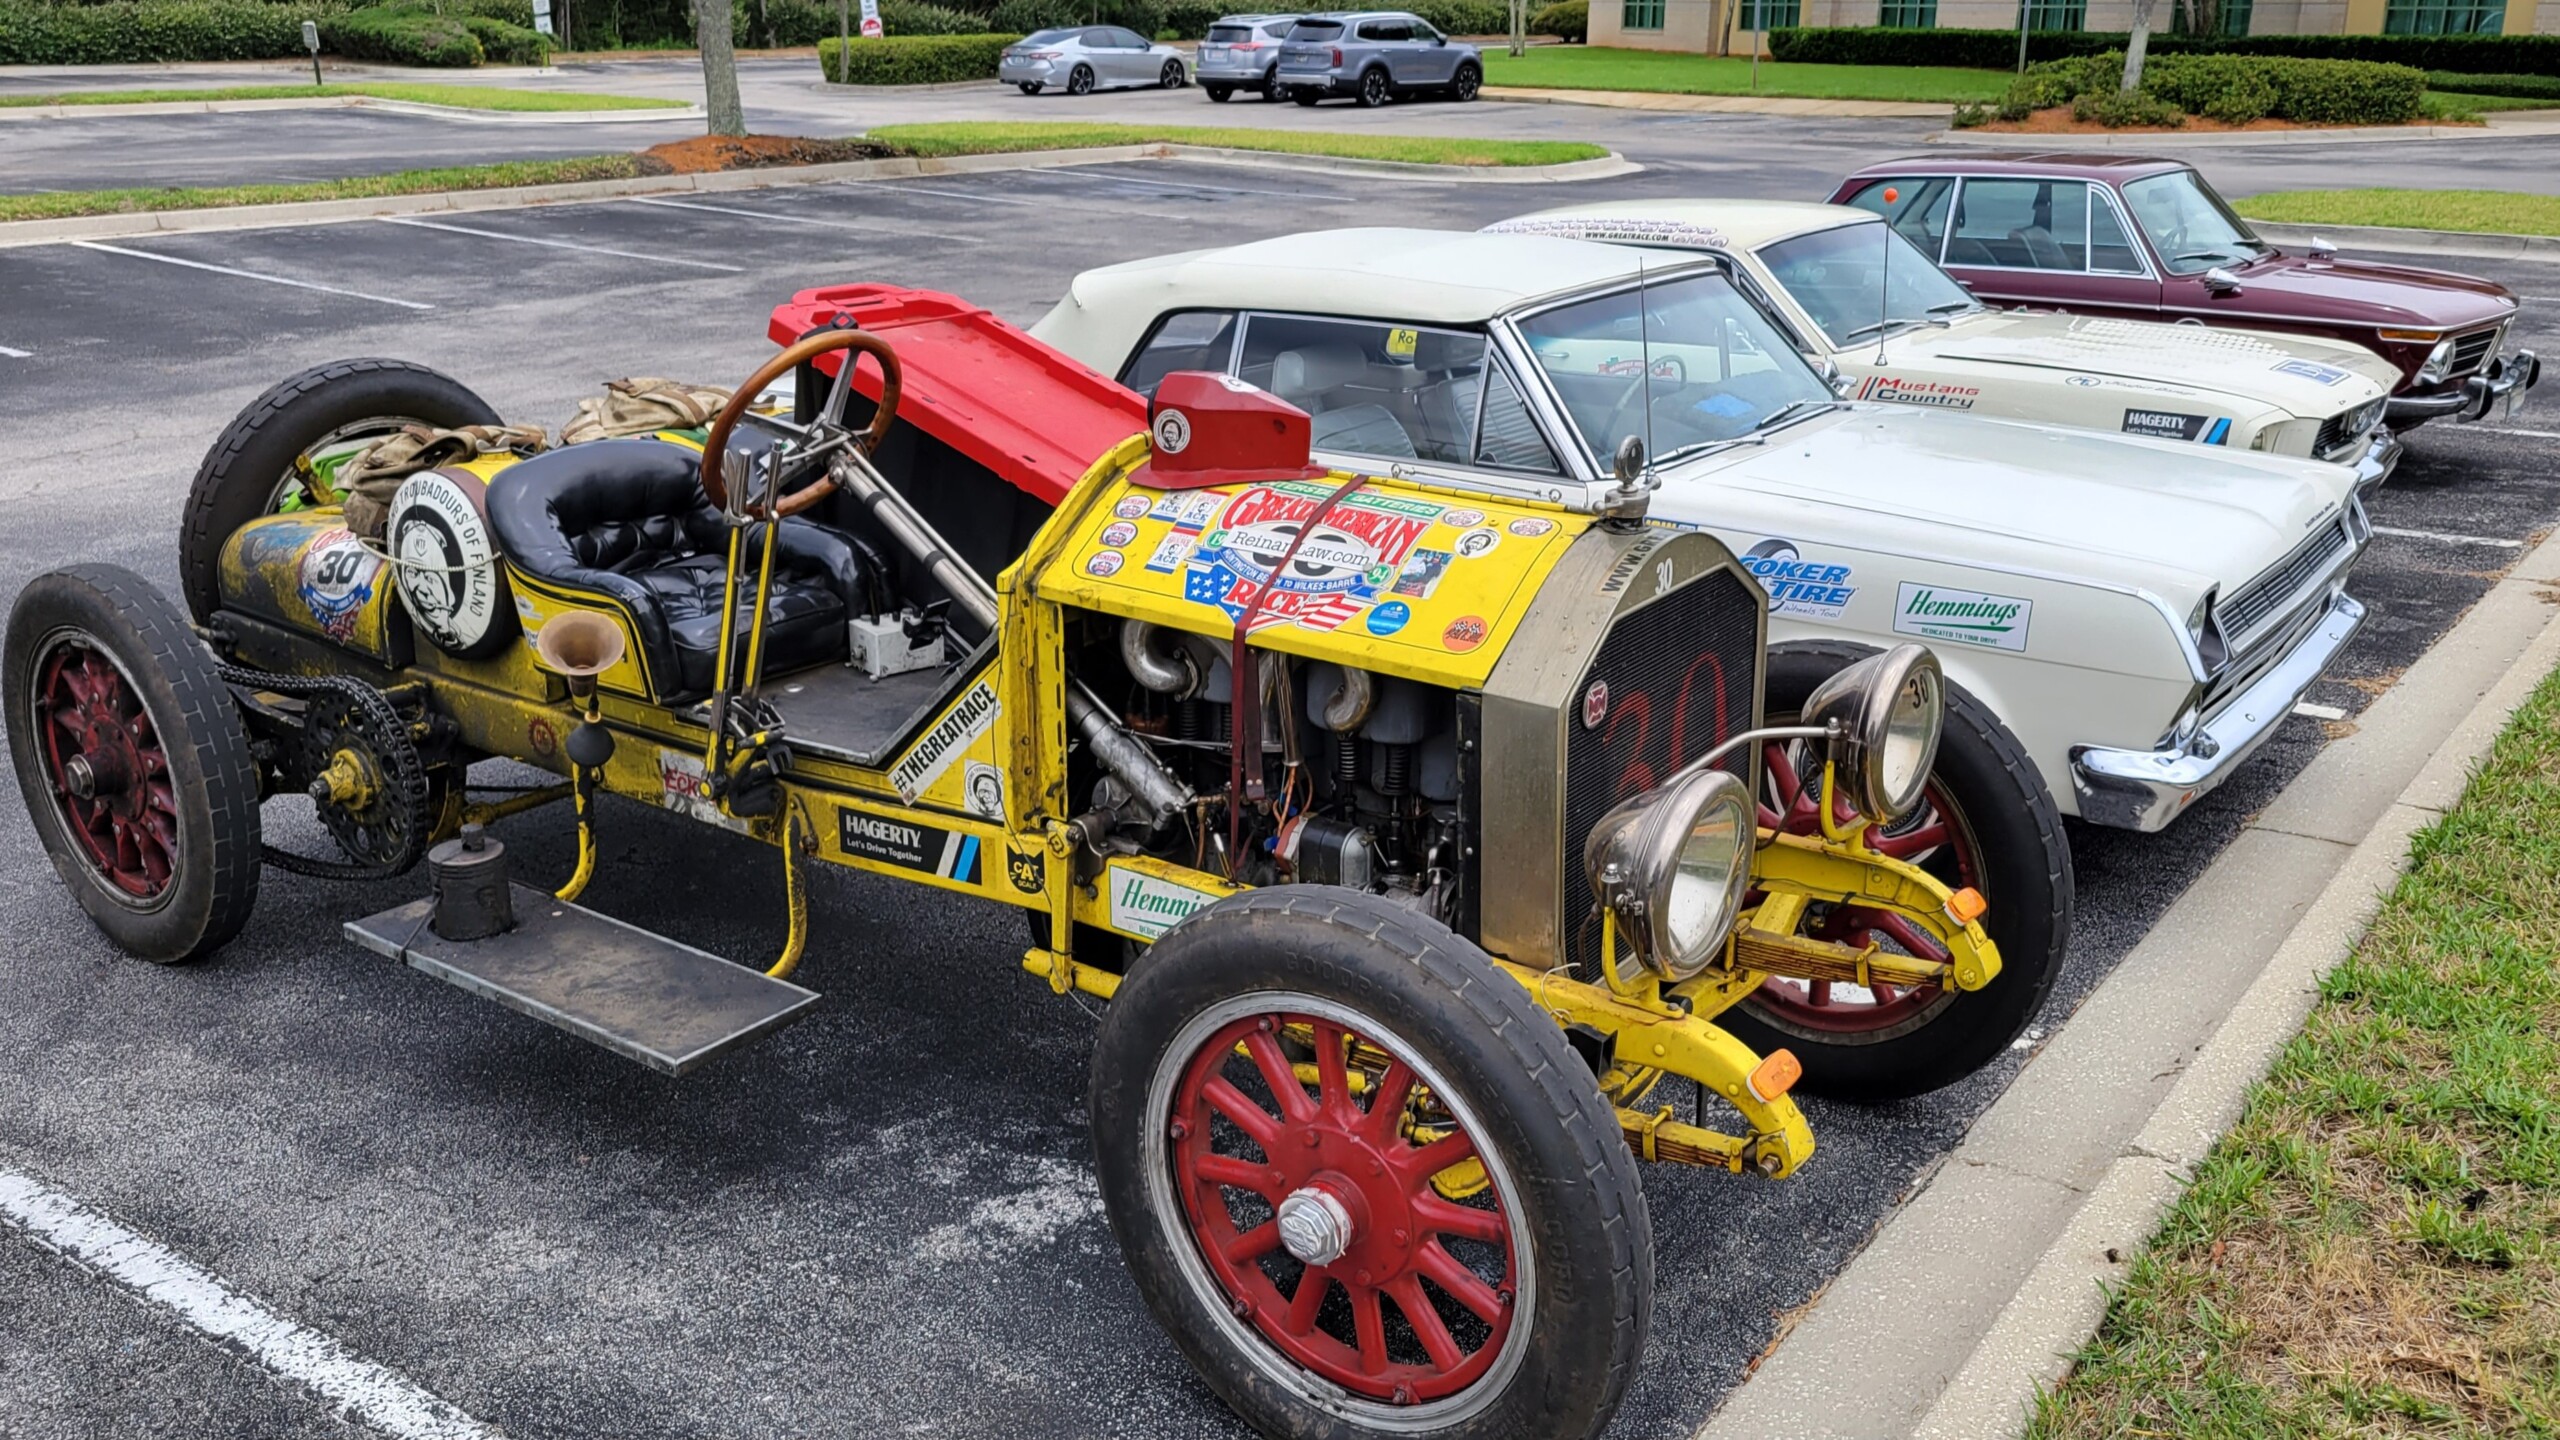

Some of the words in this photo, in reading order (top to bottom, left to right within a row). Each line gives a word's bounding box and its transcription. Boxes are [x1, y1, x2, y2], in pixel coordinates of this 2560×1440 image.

[1584, 231, 1669, 242] WWW.GREATRACE.COM
[1877, 378, 1981, 395] Mustang
[1876, 389, 1974, 409] Country
[2128, 412, 2187, 429] HAGERTY
[2158, 429, 2184, 438] Together
[399, 479, 468, 526] TROUBADOURS
[1156, 504, 1180, 513] ACE
[1355, 493, 1439, 514] BATTERIES
[1184, 511, 1209, 521] ACE
[463, 527, 481, 546] OF
[317, 551, 364, 584] 30
[1154, 554, 1178, 564] ACE
[470, 552, 487, 617] FNLAND
[1293, 577, 1357, 592] WILKES-BARRE
[1655, 557, 1674, 594] 30
[1223, 577, 1310, 616] RCE
[1769, 580, 1856, 607] TIRE
[1905, 590, 2020, 626] Hemmings
[1921, 627, 1954, 638] DEDICATED
[1955, 631, 1963, 639] TO
[1964, 632, 1979, 641] YOUR
[1980, 635, 1998, 645] DRIVE
[1910, 674, 1929, 709] 30
[893, 683, 996, 792] #THEGREATRACE
[846, 814, 921, 849] HAGERTY
[847, 838, 865, 849] Let's
[866, 842, 887, 855] Drive
[887, 847, 922, 863] Together
[1013, 860, 1039, 881] CAT
[1017, 879, 1037, 890] SCALE
[1120, 878, 1204, 917] Hemmi
